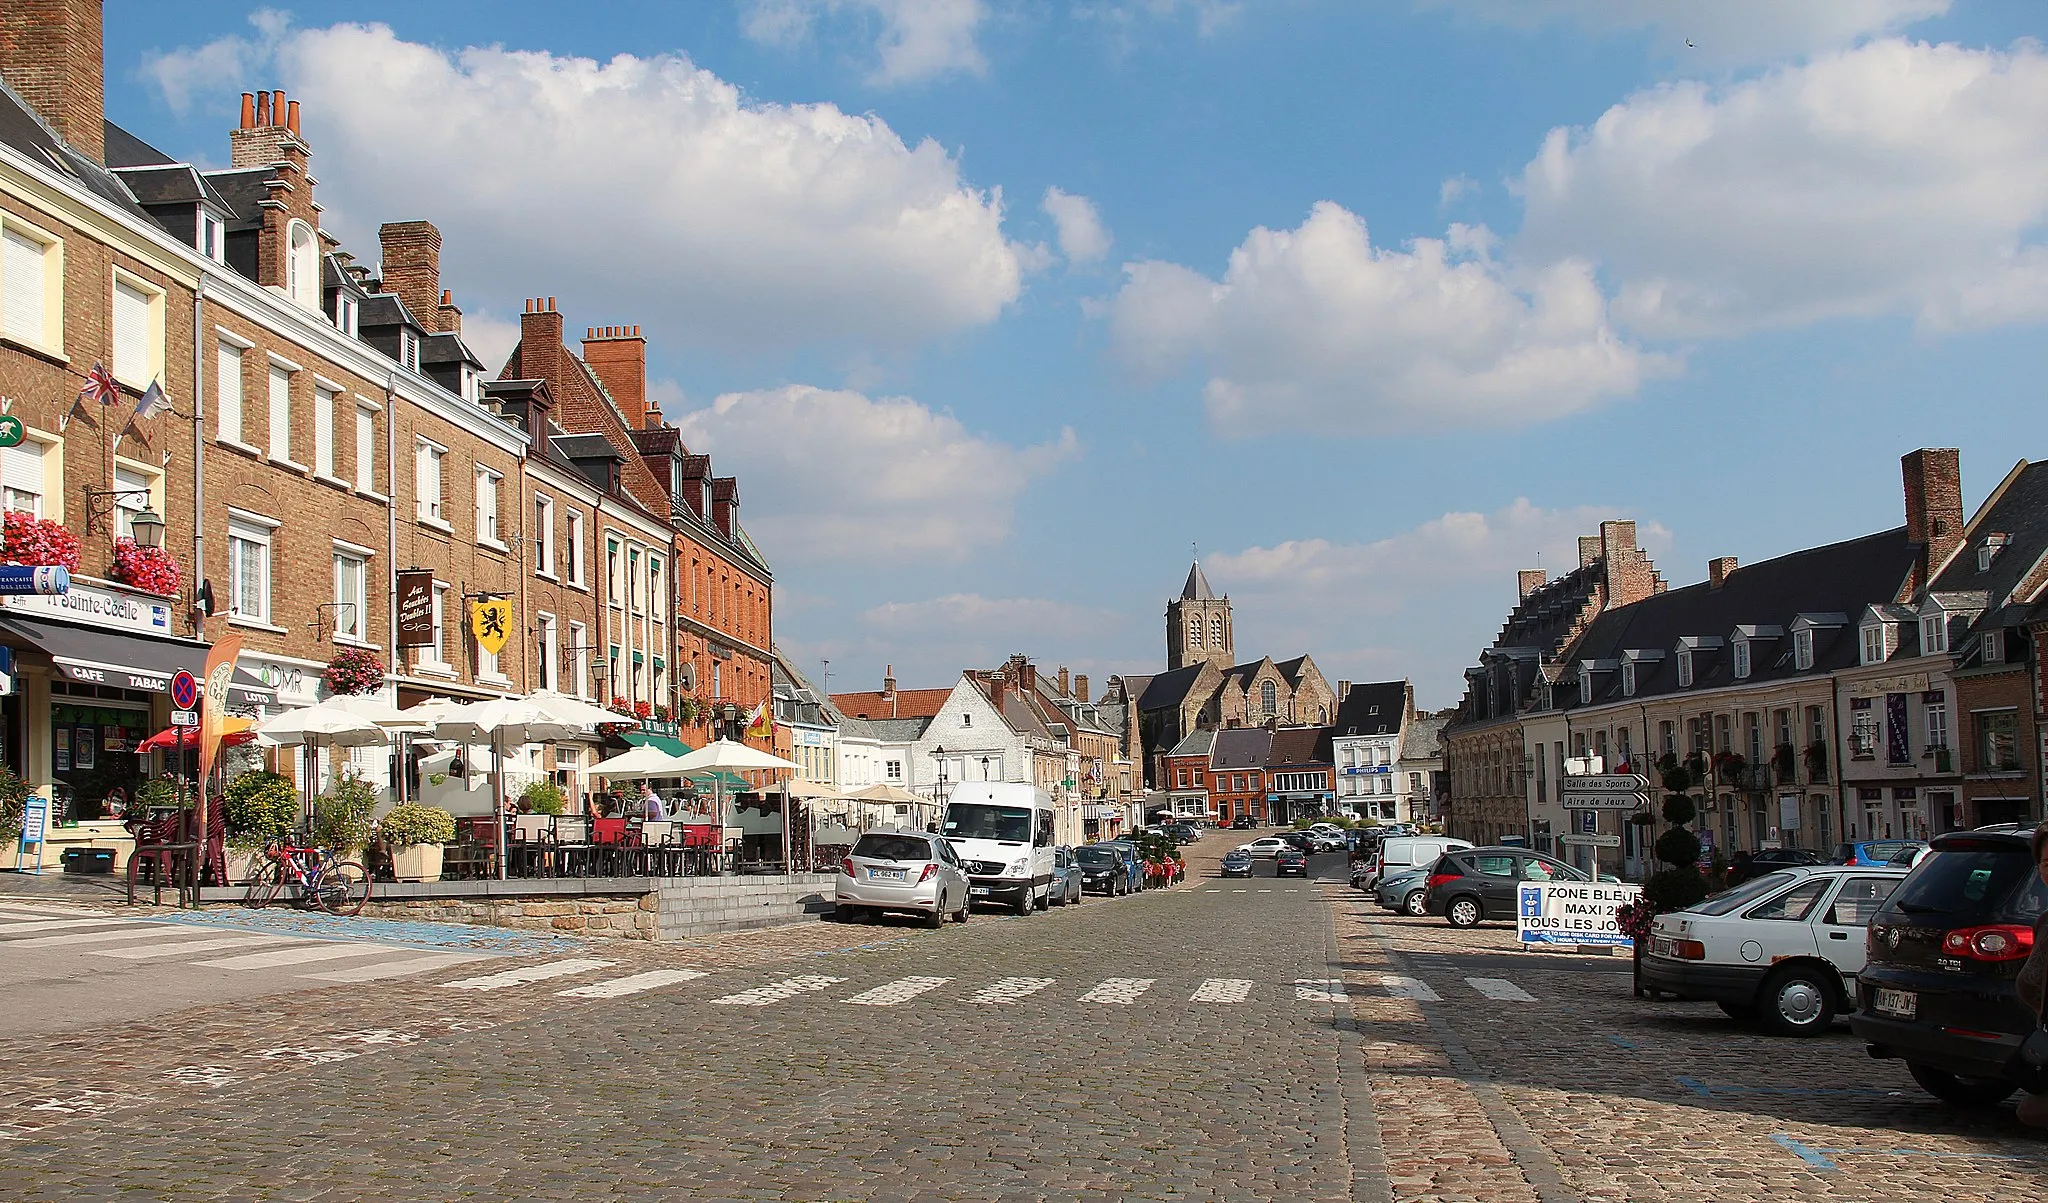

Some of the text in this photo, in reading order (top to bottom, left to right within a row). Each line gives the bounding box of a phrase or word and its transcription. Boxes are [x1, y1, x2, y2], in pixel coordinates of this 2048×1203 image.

[72, 667, 270, 704] CAFE TABAC LOTO
[1566, 780, 1631, 789] Salle des Sports
[1566, 797, 1626, 806] Aire de Jeux
[1586, 813, 1592, 823] P
[1547, 887, 1589, 900] ZONE
[1565, 903, 1618, 916] MAXI 2
[1521, 917, 1560, 928] TOUS
[1564, 918, 1593, 930] LES
[1948, 959, 1961, 967] TDI
